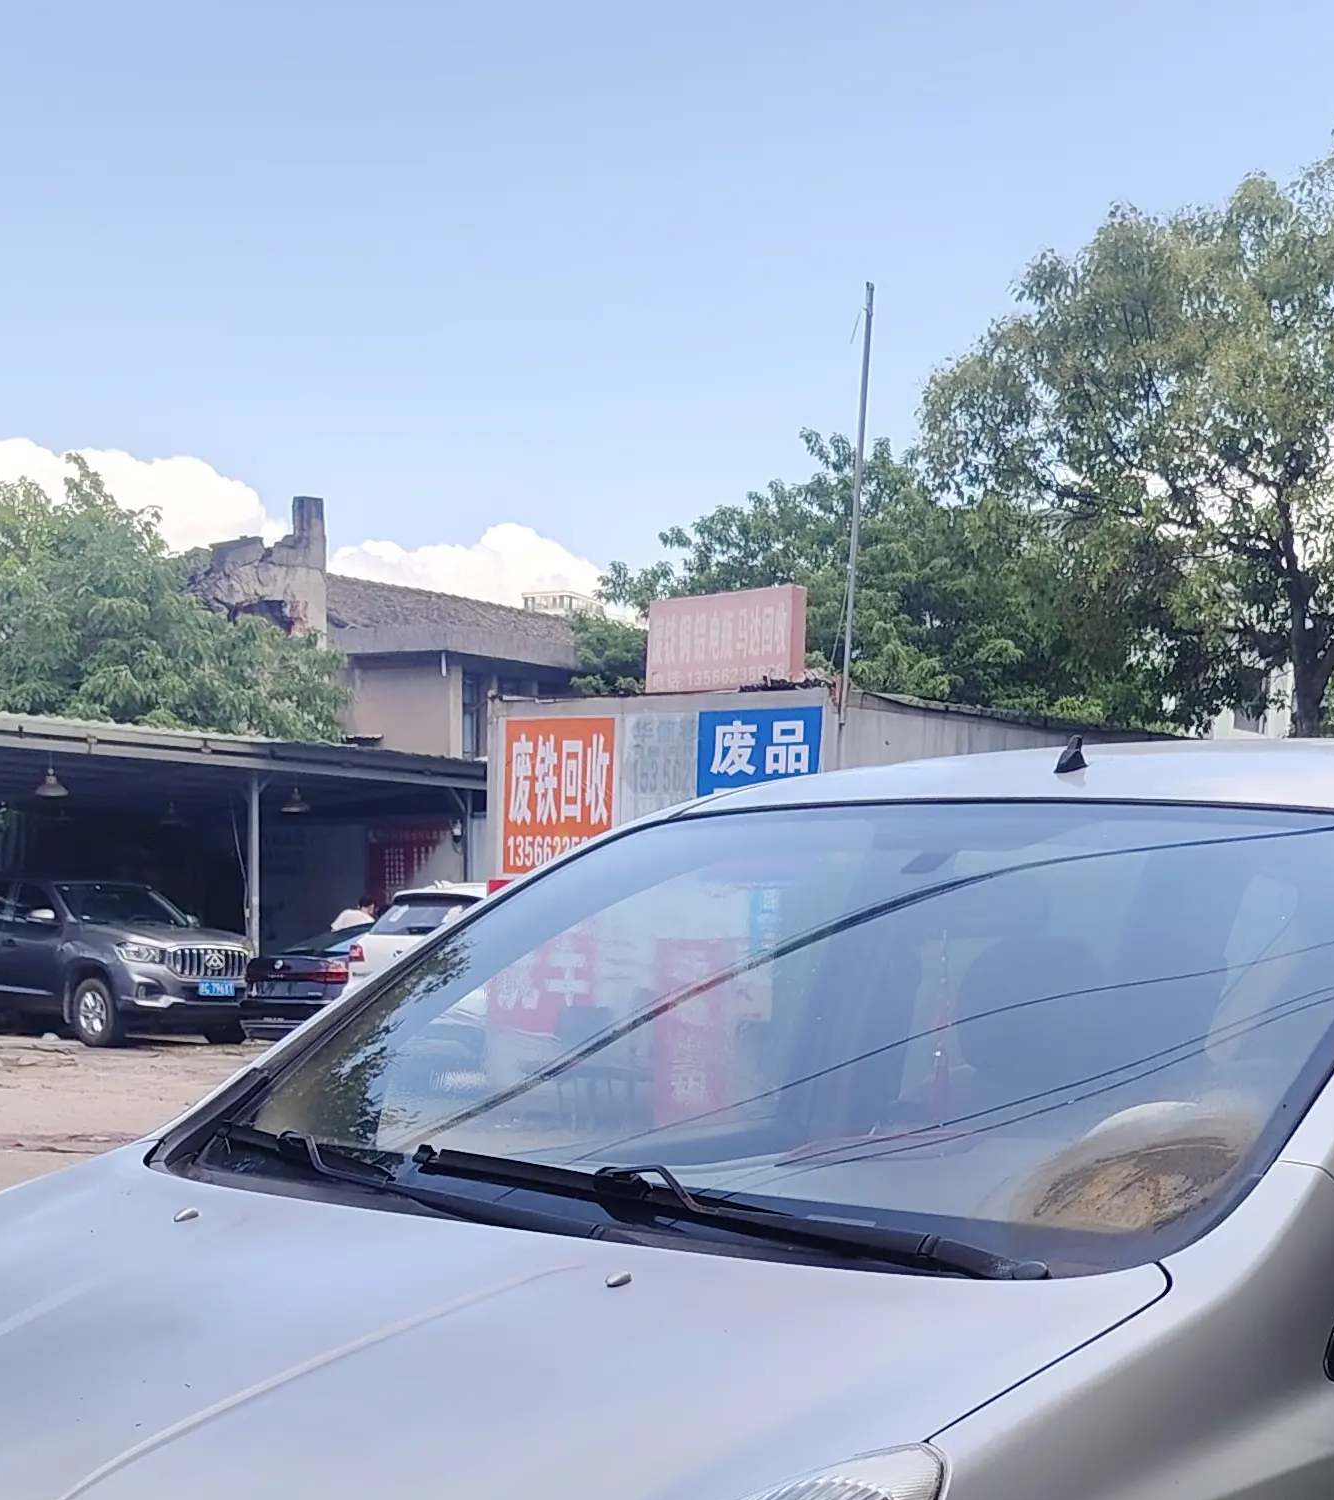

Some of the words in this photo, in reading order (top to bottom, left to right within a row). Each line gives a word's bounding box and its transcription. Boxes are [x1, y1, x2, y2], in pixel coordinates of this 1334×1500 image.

[508, 733, 610, 826] 废铁回收
[710, 720, 810, 776] 废品
